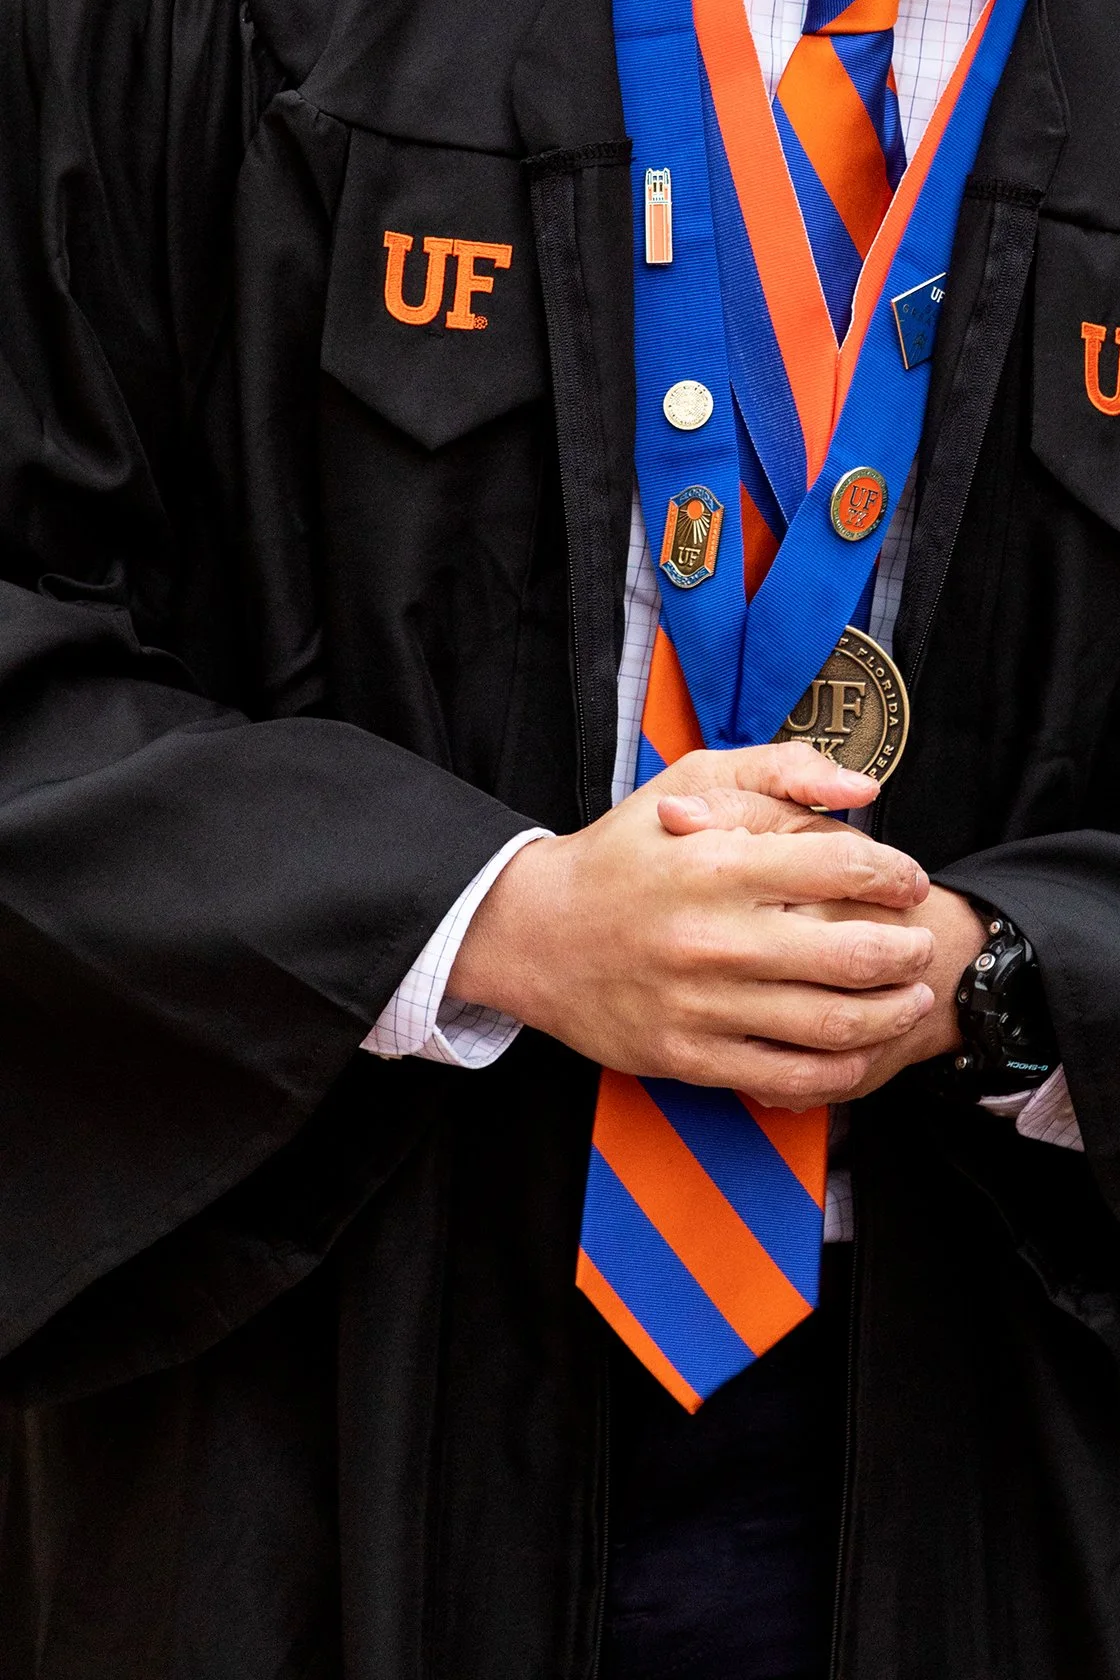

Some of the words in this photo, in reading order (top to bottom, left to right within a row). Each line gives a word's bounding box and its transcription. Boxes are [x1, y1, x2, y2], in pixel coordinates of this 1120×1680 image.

[383, 230, 513, 330] UF
[930, 286, 945, 303] UF
[850, 485, 878, 510] UF
[678, 546, 701, 566] UF
[856, 647, 899, 727] FLORIDA
[782, 679, 866, 734] UF
[790, 735, 845, 769] K
[868, 743, 895, 779] PER
[1006, 1060, 1049, 1071] G-SHOCK
